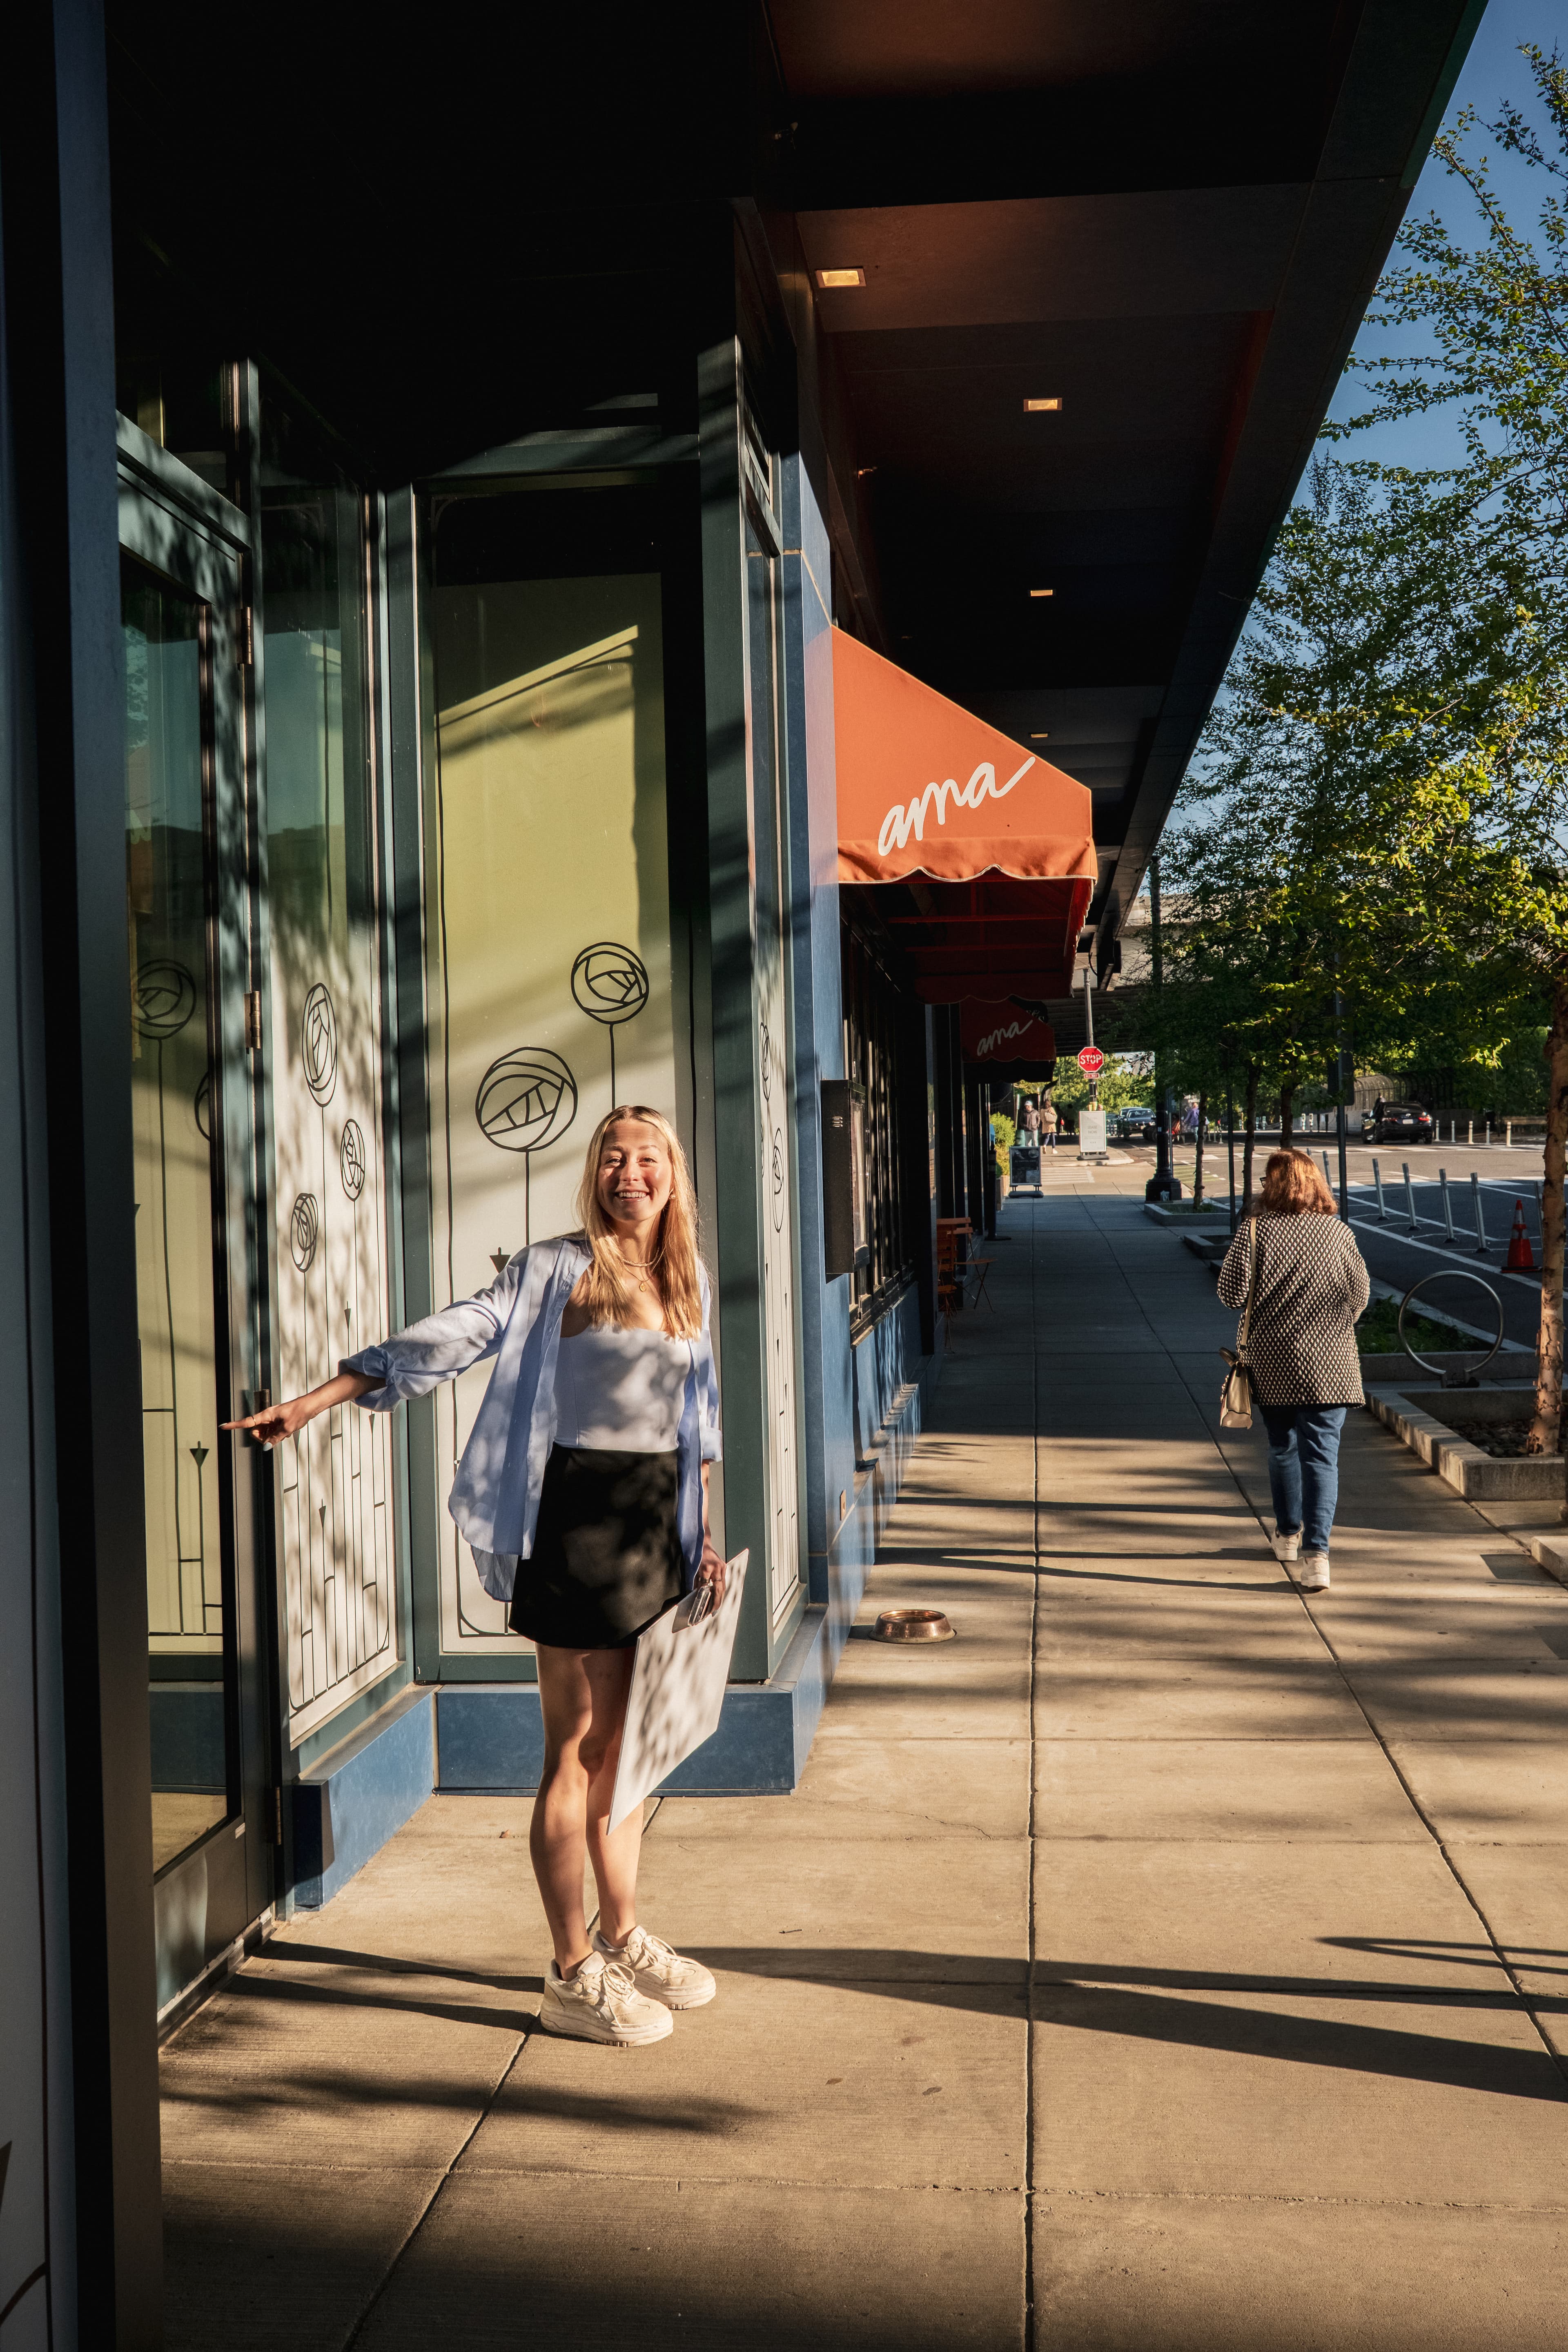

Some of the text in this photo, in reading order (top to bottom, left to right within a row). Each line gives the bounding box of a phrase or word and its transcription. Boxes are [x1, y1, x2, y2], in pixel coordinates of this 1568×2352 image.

[878, 757, 1036, 856] ama
[977, 1019, 1033, 1056] ama
[1080, 1054, 1102, 1065] STOP
